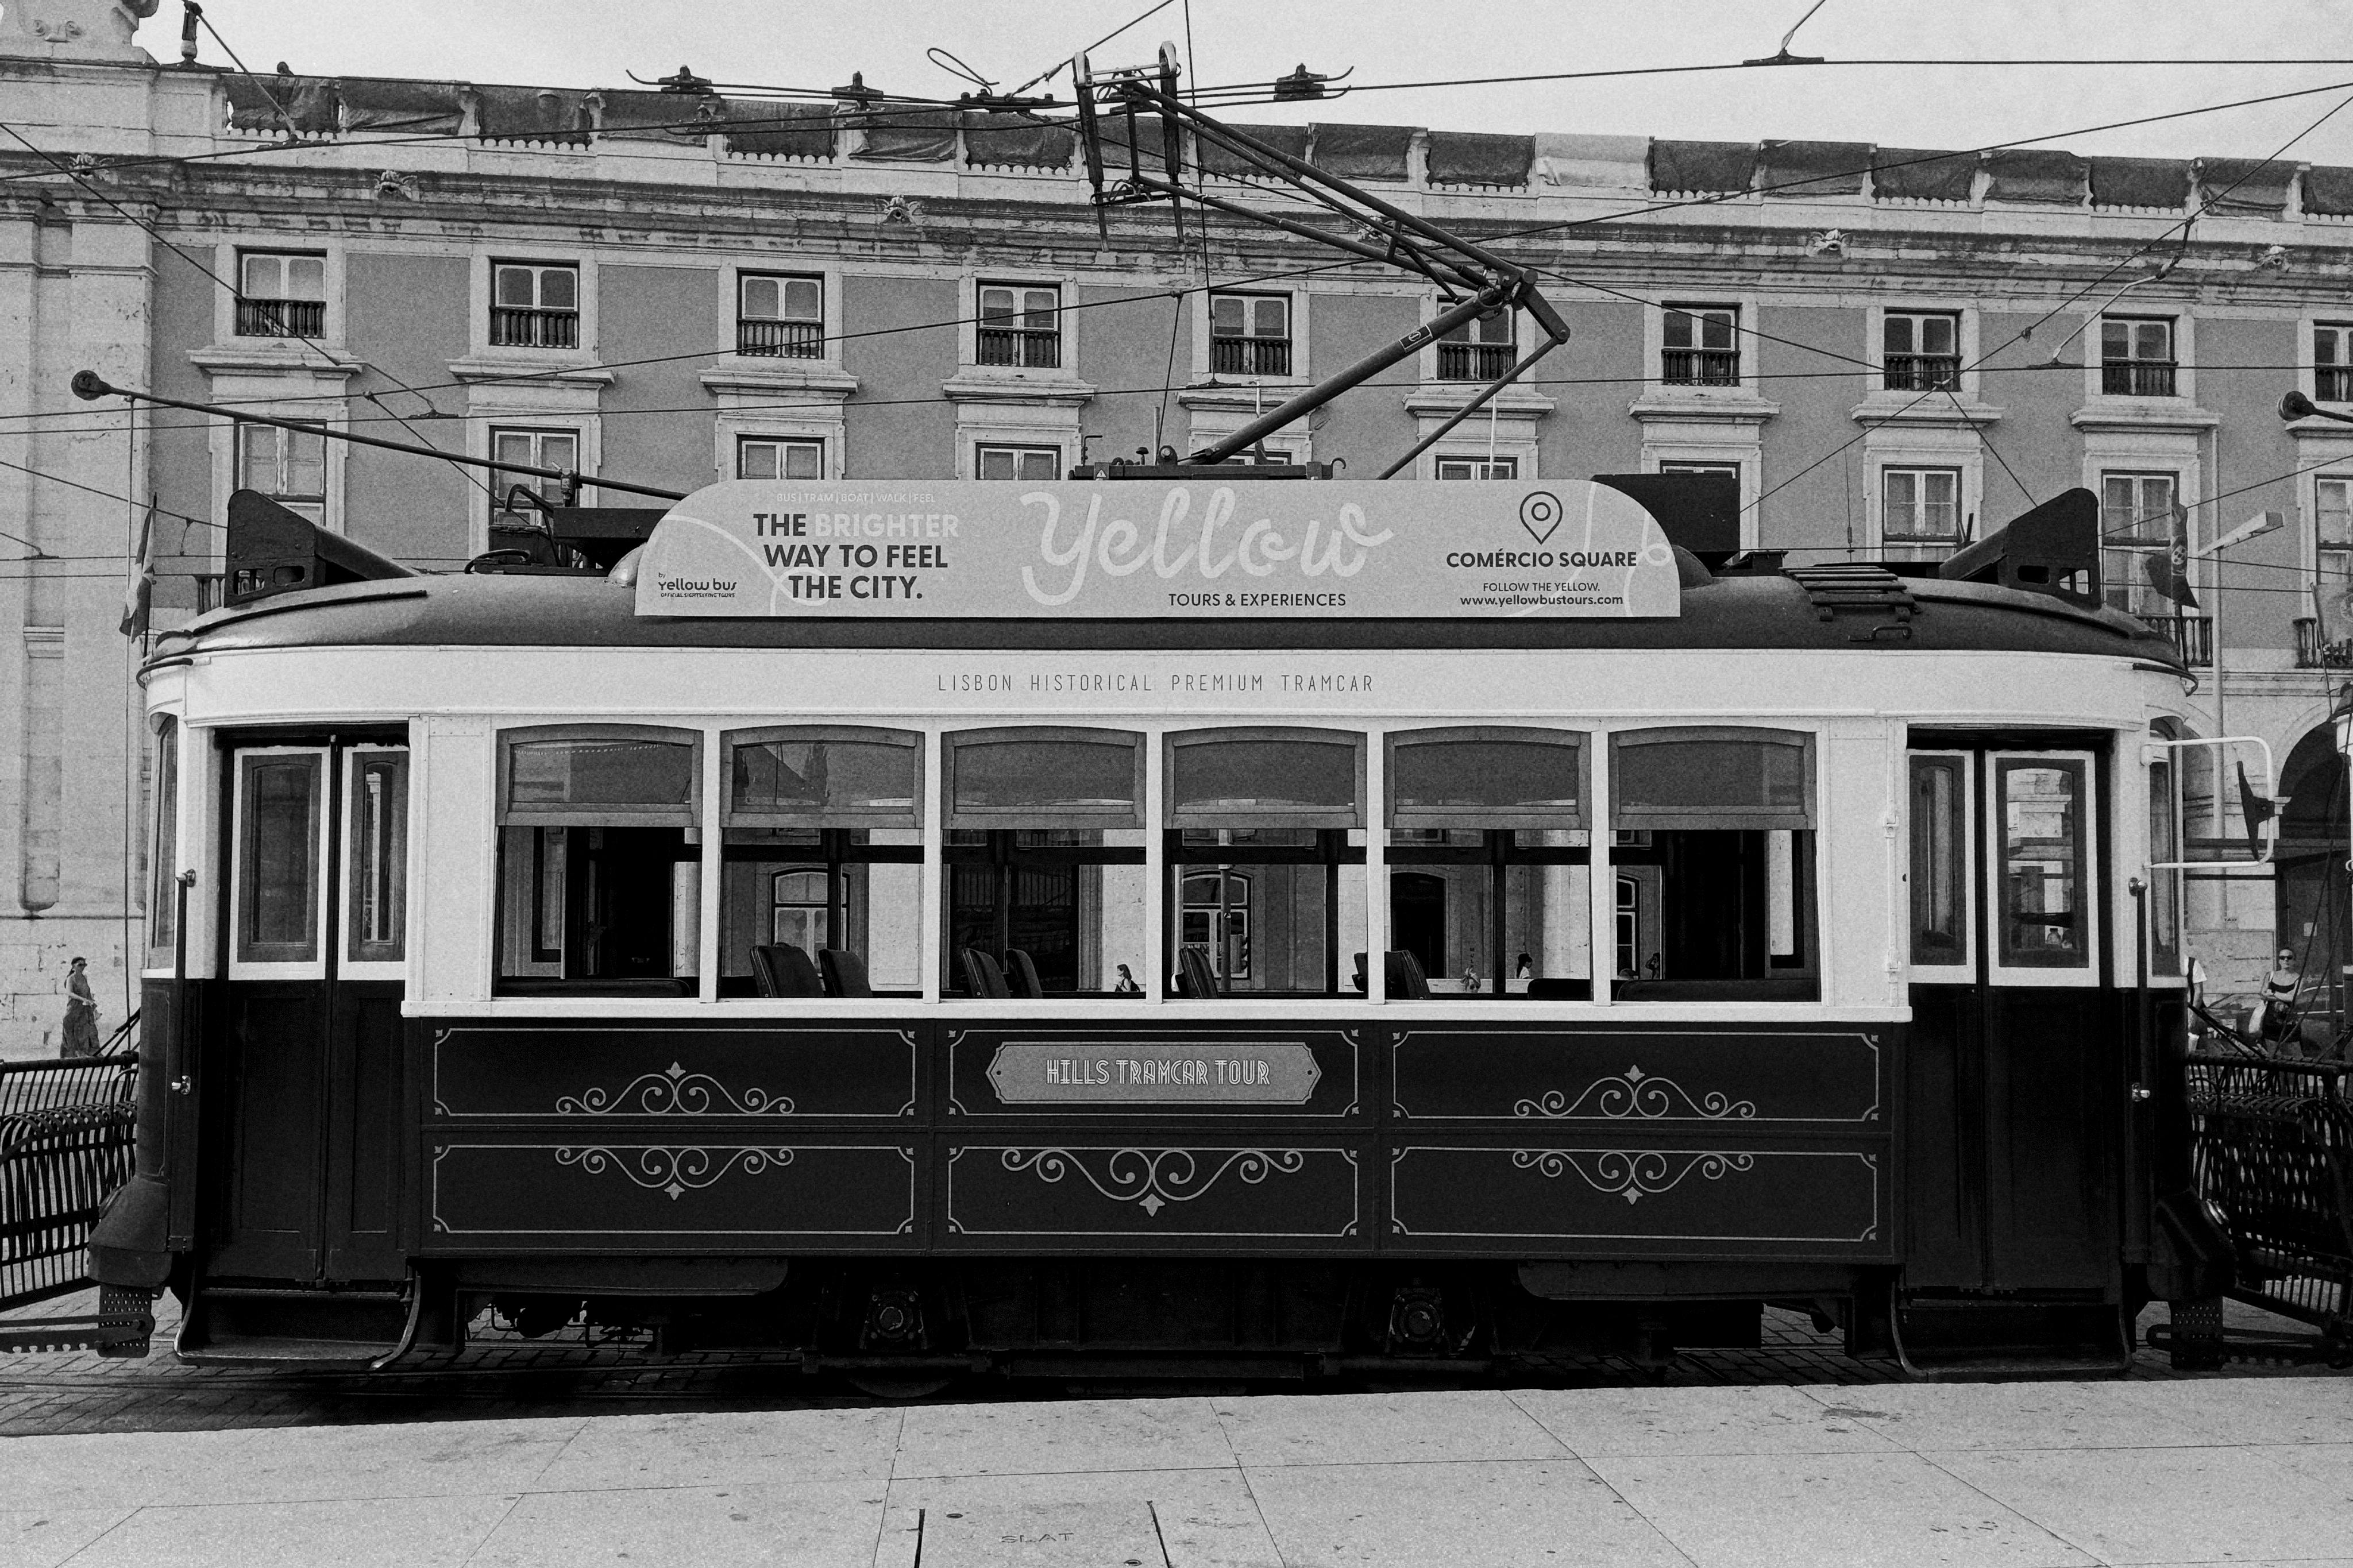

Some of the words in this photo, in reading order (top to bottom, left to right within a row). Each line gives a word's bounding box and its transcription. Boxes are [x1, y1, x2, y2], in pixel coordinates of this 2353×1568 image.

[777, 493, 796, 502] BUS
[804, 493, 833, 502] TRAM
[841, 493, 869, 503] BOAT
[875, 493, 907, 503] WALK
[913, 493, 936, 503] FEEL
[753, 513, 807, 536] THE
[815, 513, 959, 538] BRIGHTER
[763, 544, 831, 567] WAY
[839, 544, 878, 568] TO
[886, 544, 948, 568] FEEL
[1446, 548, 1554, 568] COMÉRCIO
[1559, 551, 1637, 567] SQUARE
[712, 578, 737, 590] bus
[788, 575, 842, 598] THE
[850, 576, 923, 599] CITY.
[1483, 582, 1530, 592] FOLLOW
[1532, 582, 1552, 592] THE
[1554, 582, 1600, 592] YELLOW.
[1168, 593, 1220, 607] TOURS
[1225, 593, 1236, 607] &
[1241, 593, 1346, 607] EXPERIENCES
[1460, 594, 1623, 608] www.yellowbustours.com
[938, 674, 1012, 692] LISBON
[1031, 674, 1152, 692] HISTORICAL
[1171, 674, 1263, 692] PREMIUM
[1281, 674, 1373, 692] TRAMCAR
[1047, 1059, 1110, 1084] HILLS
[1116, 1060, 1208, 1085] TRAMCAR
[1214, 1060, 1270, 1084] TOUR
